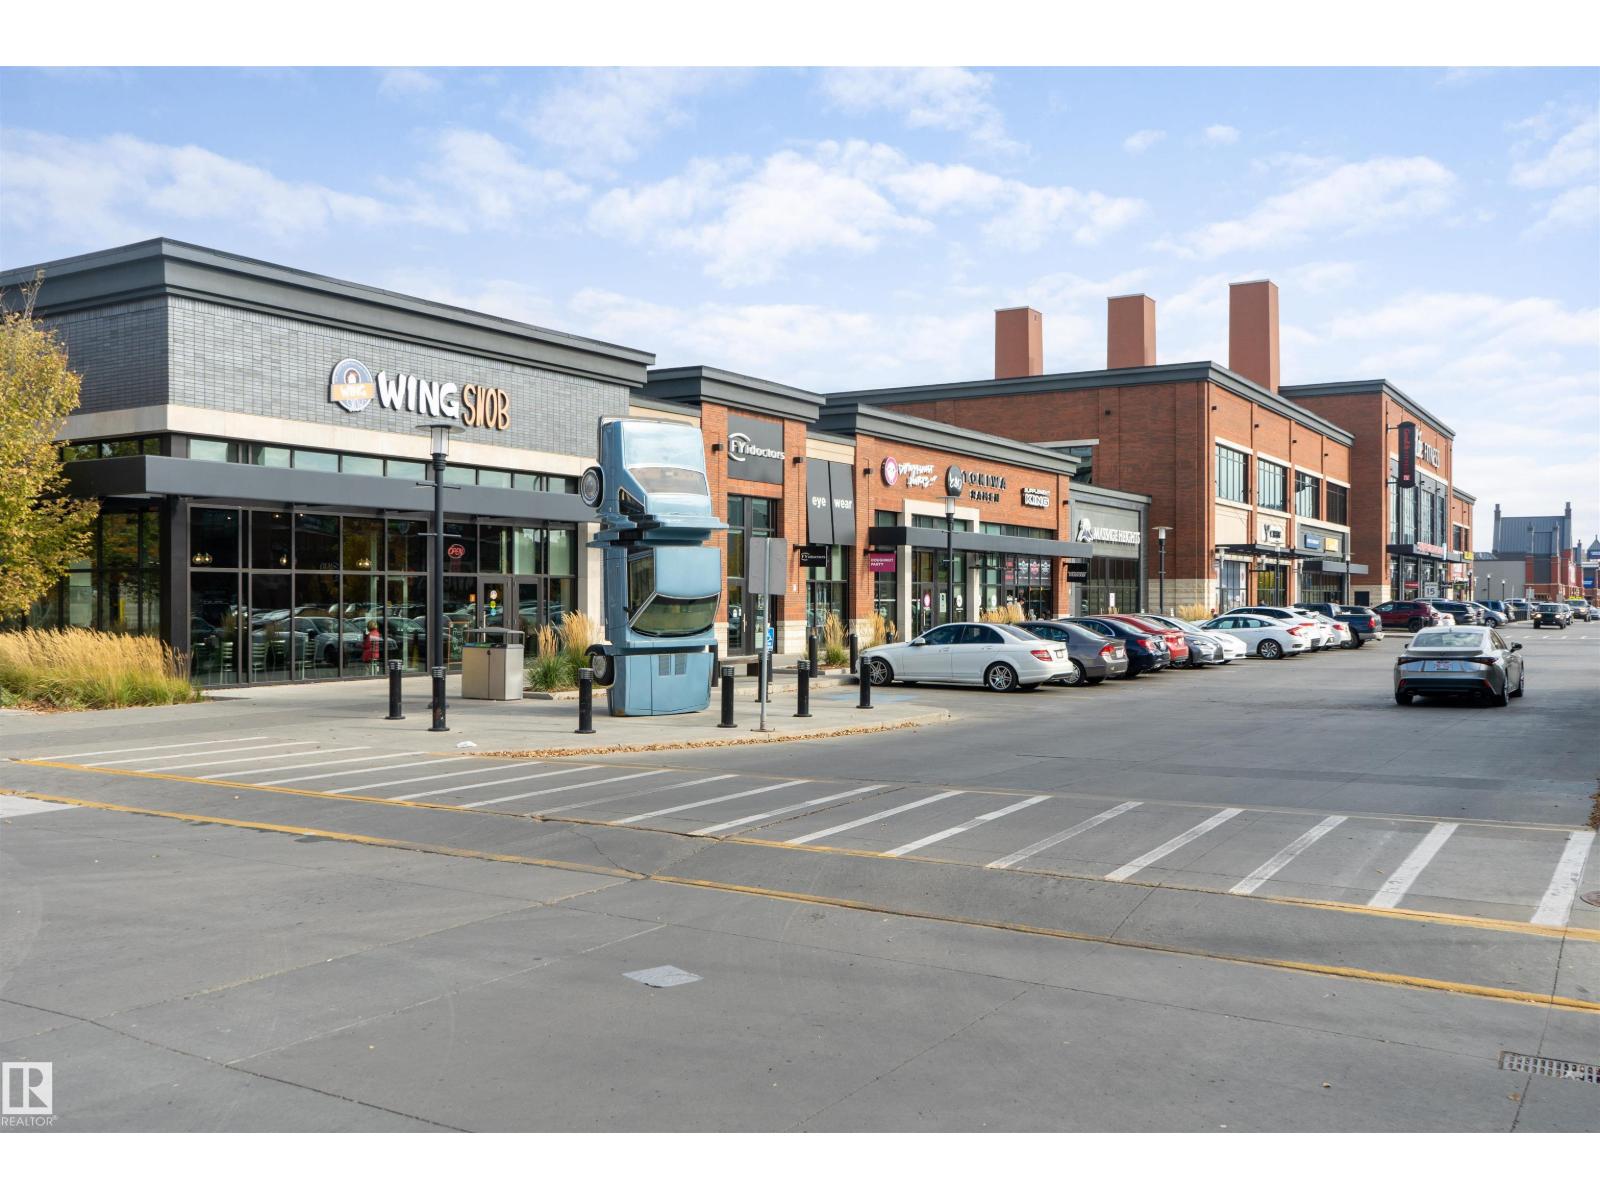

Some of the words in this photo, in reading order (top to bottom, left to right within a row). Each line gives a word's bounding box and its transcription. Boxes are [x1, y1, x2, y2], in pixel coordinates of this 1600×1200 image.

[376, 370, 459, 419] WING
[463, 383, 511, 430] SNOB
[811, 496, 827, 508] eye
[834, 498, 853, 510] wear
[1025, 493, 1050, 508] KING
[448, 546, 465, 556] OPEN
[1426, 587, 1436, 595] 15
